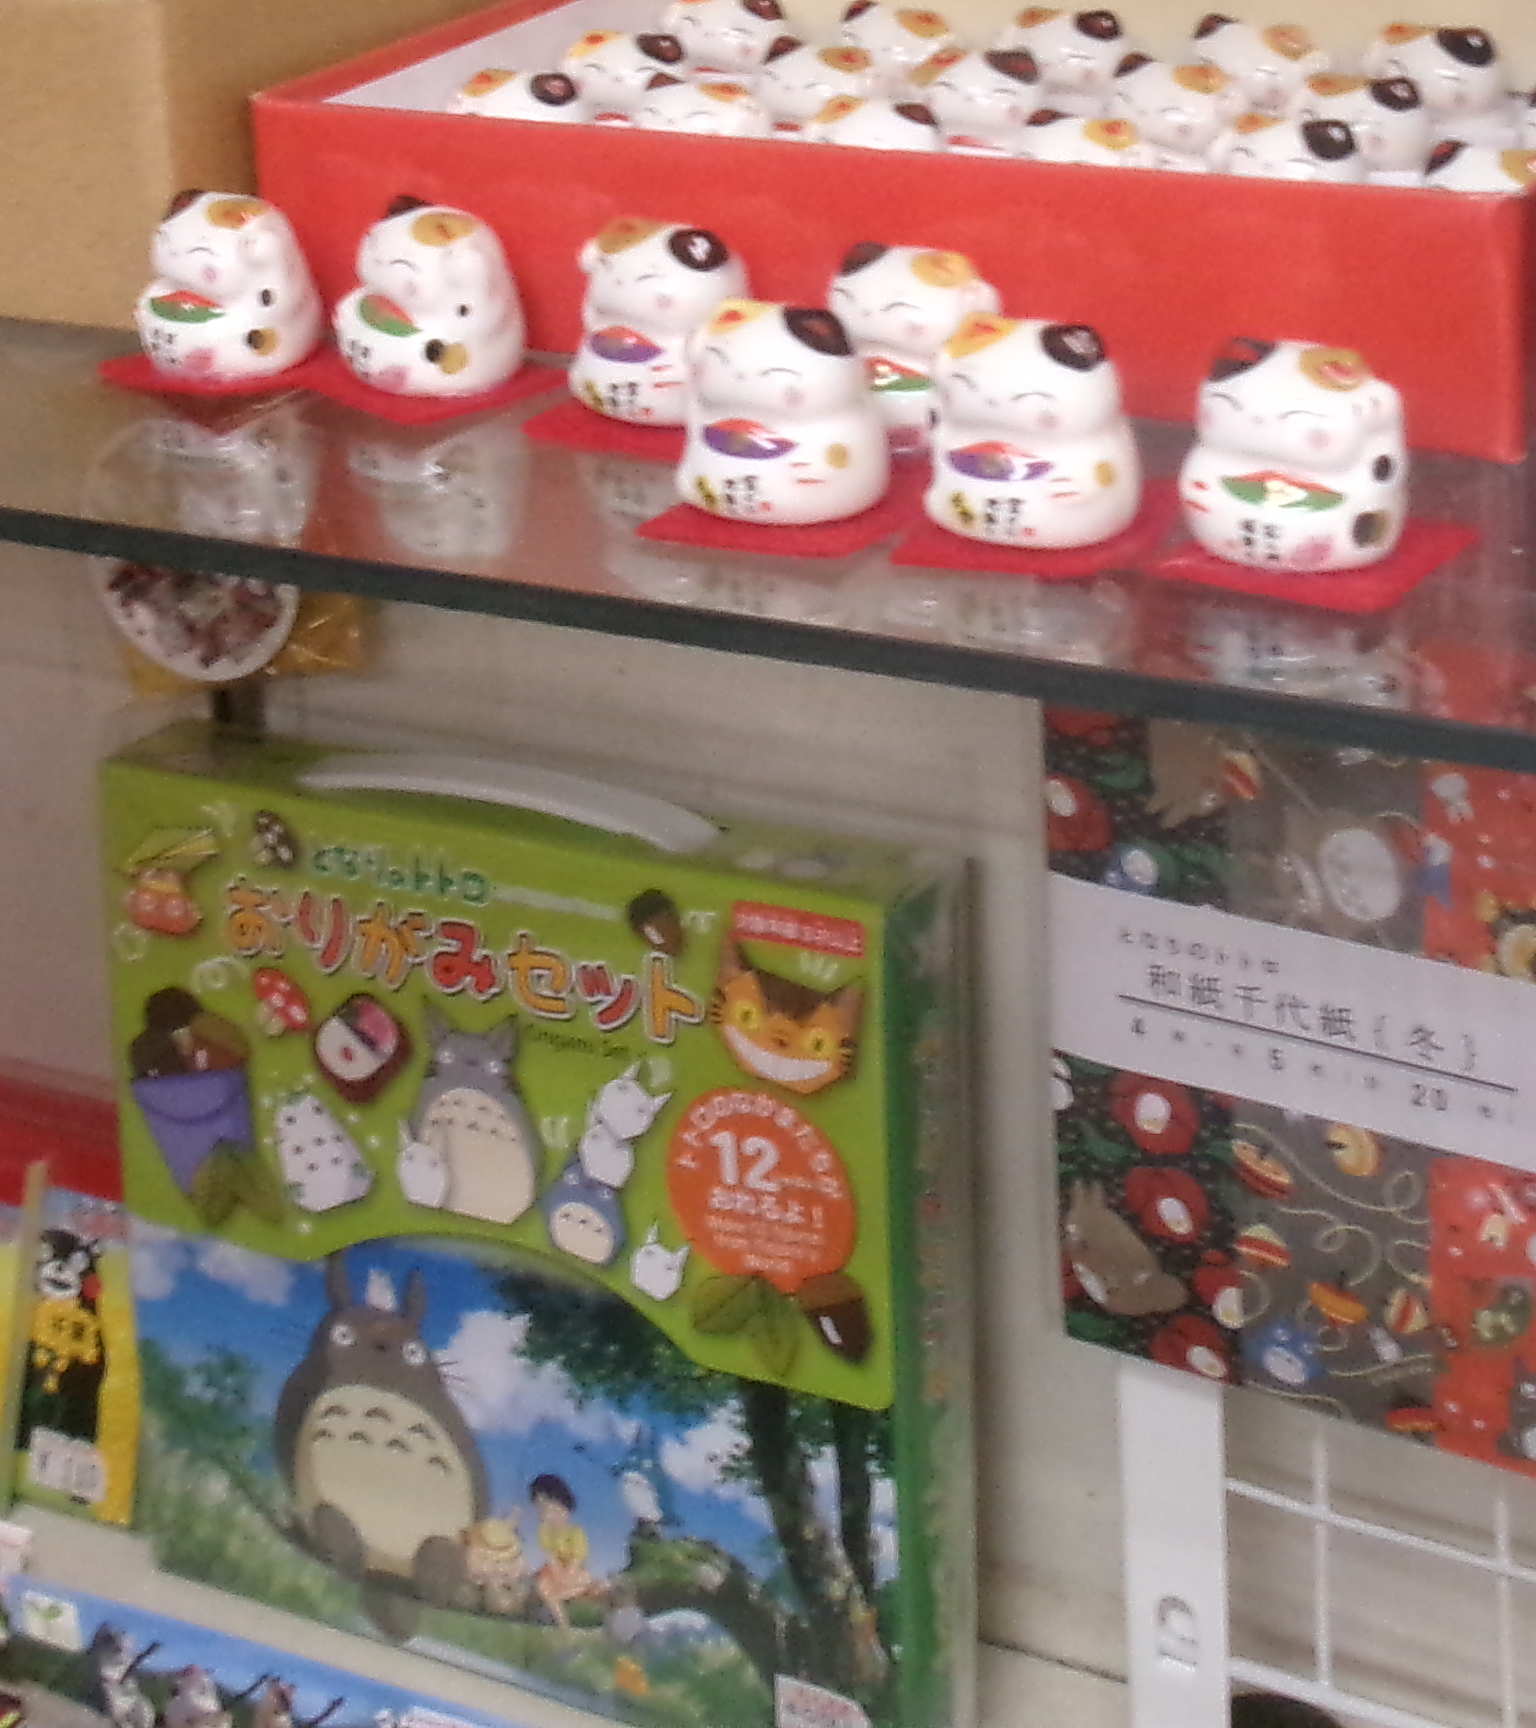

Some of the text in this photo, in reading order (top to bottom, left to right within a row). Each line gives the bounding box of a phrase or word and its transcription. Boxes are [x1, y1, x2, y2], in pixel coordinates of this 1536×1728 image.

[228, 874, 705, 1044] おりがみセット
[710, 1130, 781, 1192] 12
